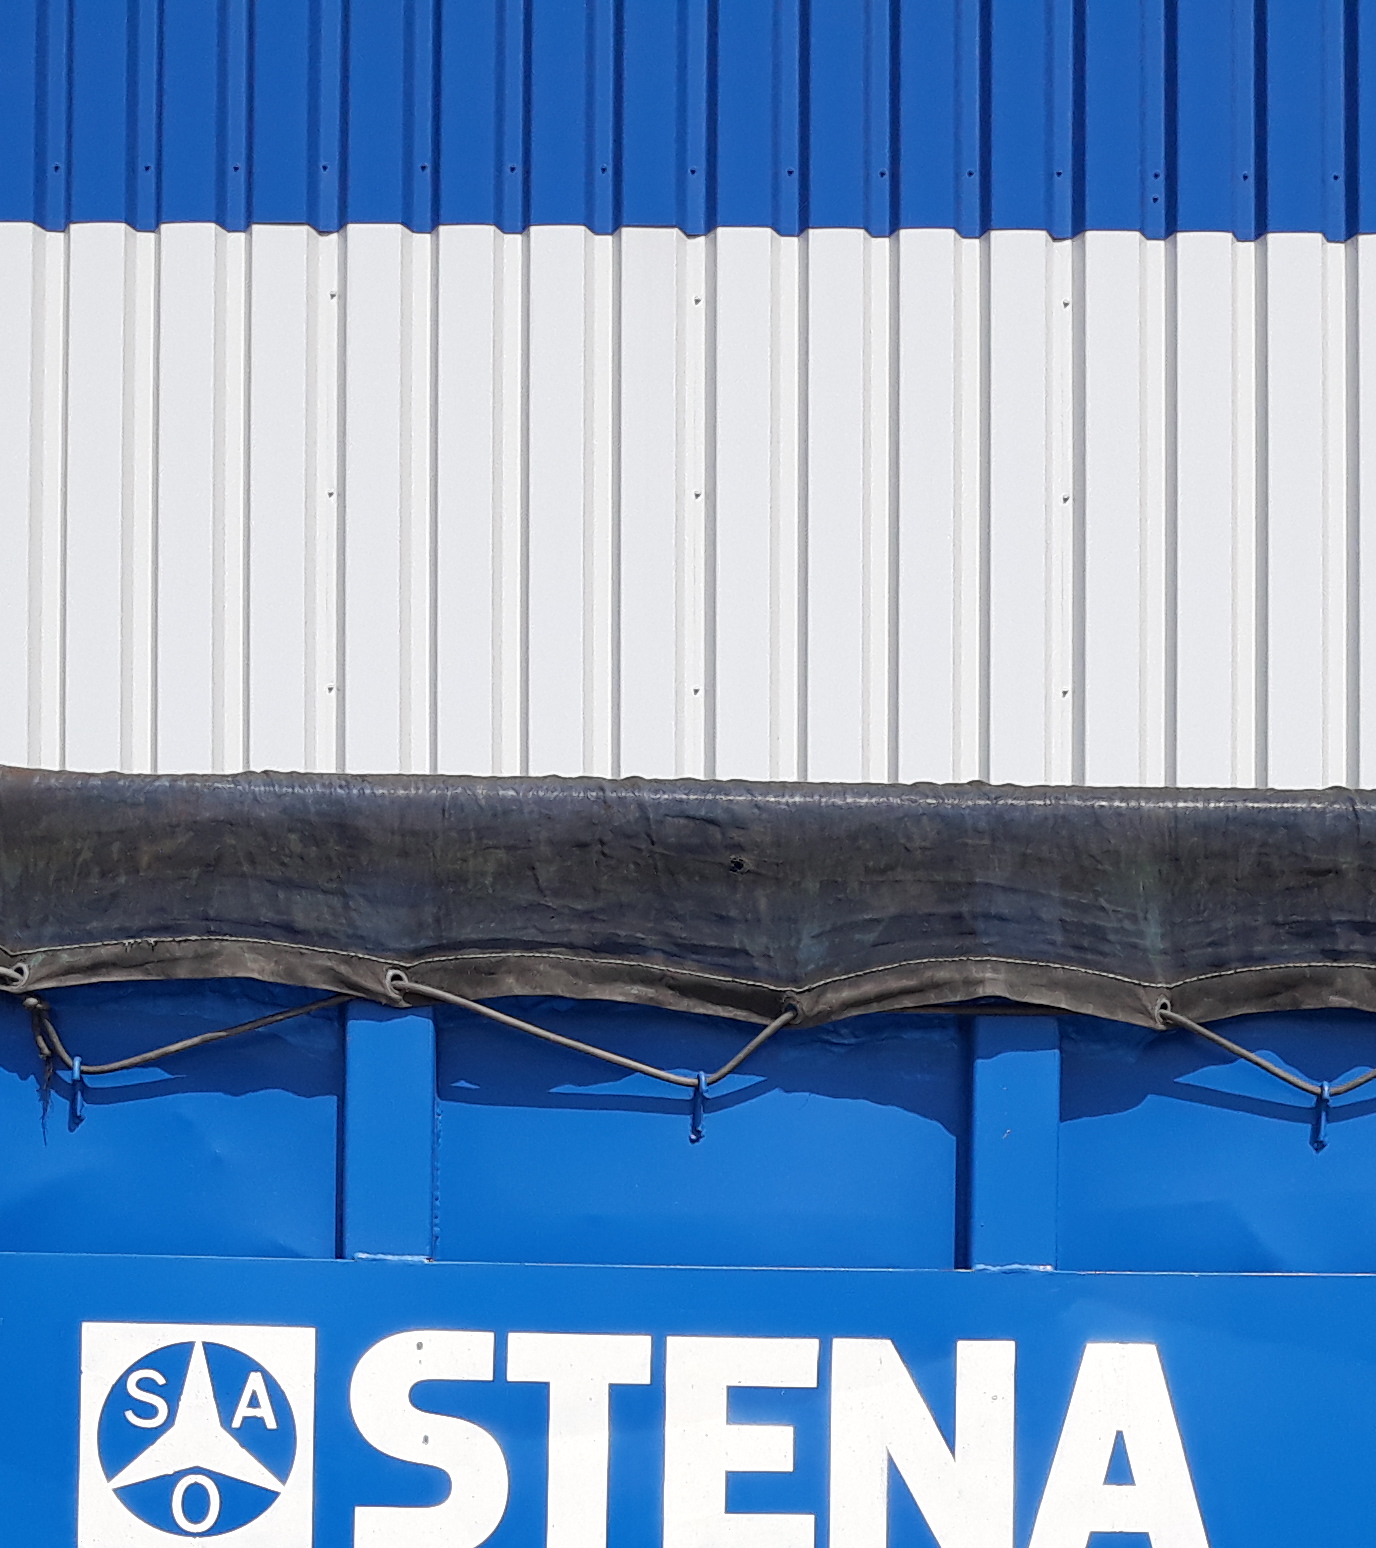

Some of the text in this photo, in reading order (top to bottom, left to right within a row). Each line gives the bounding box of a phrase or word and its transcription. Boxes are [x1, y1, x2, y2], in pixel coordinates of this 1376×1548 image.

[124, 1368, 278, 1430] S A
[171, 1474, 221, 1534] O
